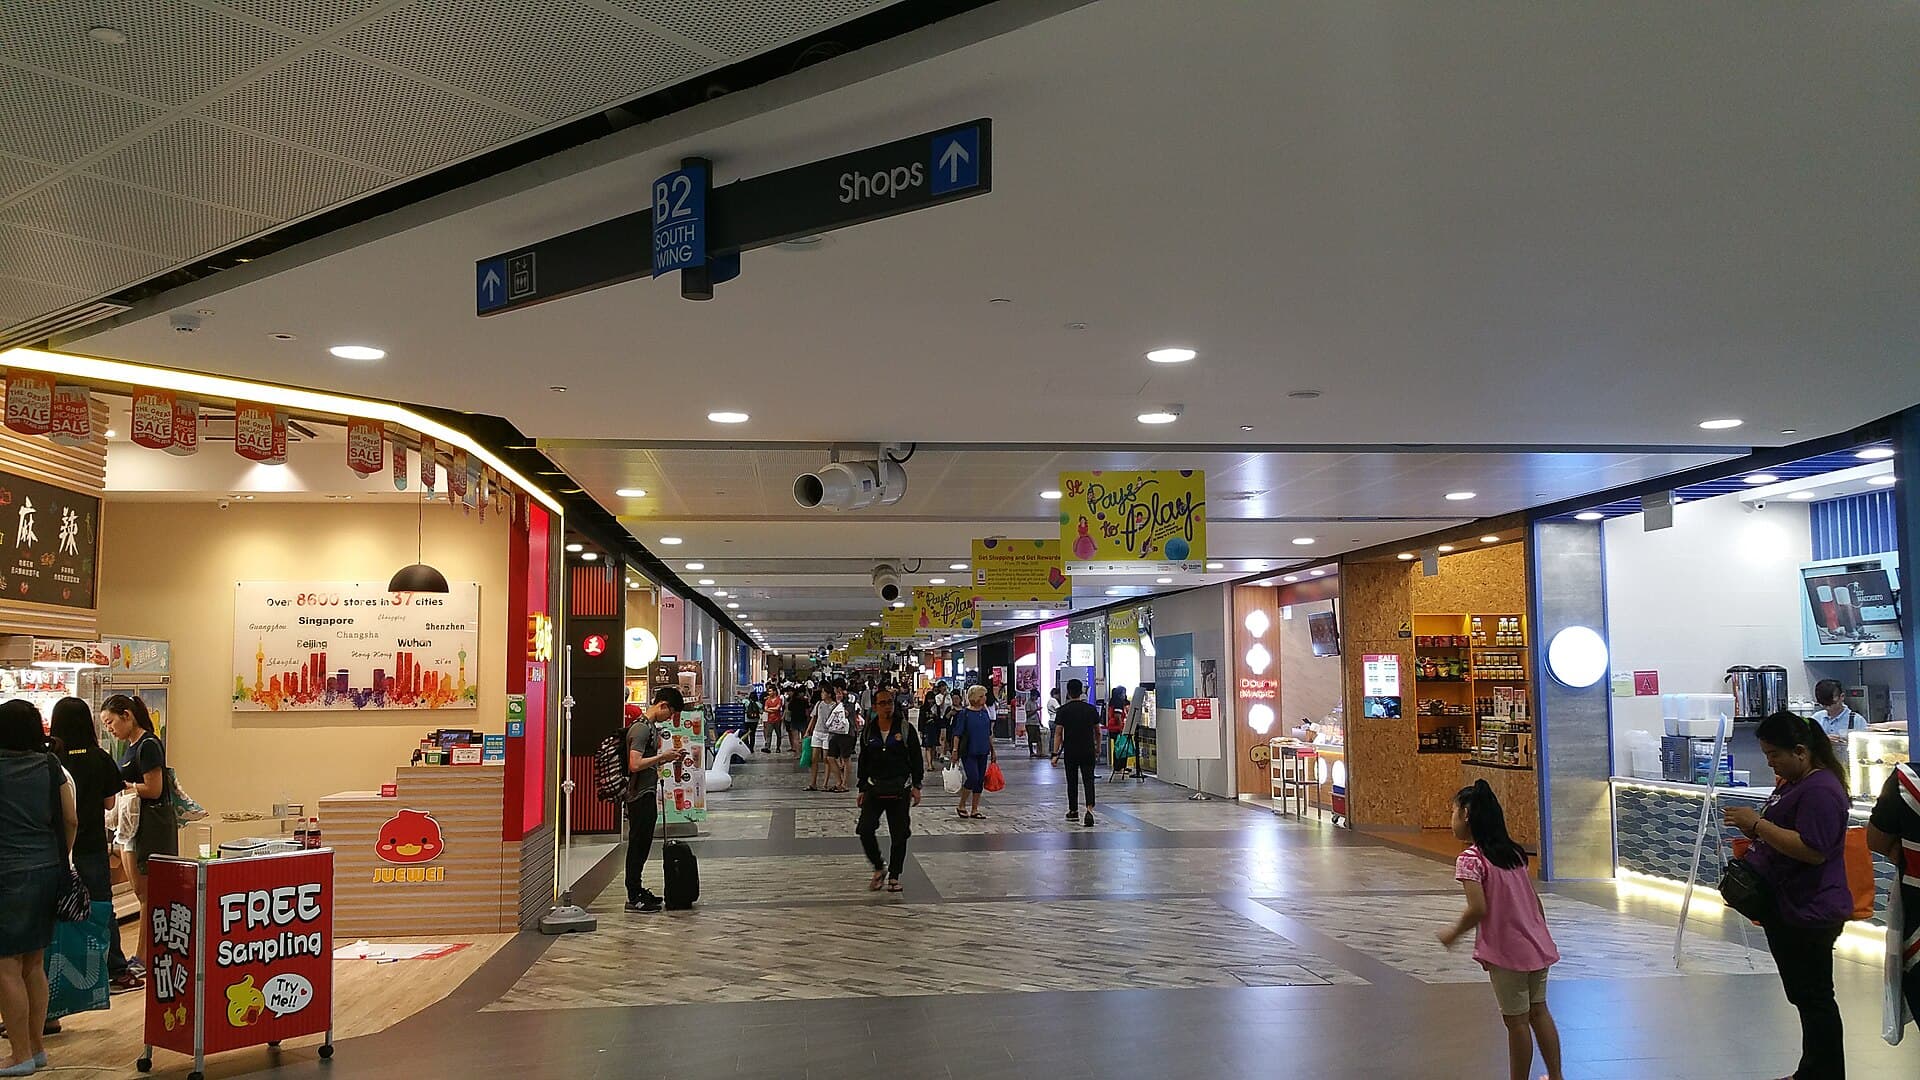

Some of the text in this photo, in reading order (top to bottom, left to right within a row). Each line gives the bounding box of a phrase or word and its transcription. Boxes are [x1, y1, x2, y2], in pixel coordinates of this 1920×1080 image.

[839, 160, 923, 204] Shops
[656, 175, 692, 226] B2
[655, 224, 696, 250] SOUTH
[656, 244, 692, 270] WING
[9, 404, 49, 421] SALE
[52, 419, 89, 432] SALE
[136, 420, 170, 436] SALE
[174, 430, 195, 444] ALE
[239, 433, 271, 448] SALE
[350, 447, 379, 462] SALE
[422, 463, 435, 473] SALE
[1066, 479, 1159, 515] It Pays
[16, 495, 39, 549] 麻
[1100, 520, 1120, 538] to
[1120, 491, 1205, 552] Play
[59, 506, 79, 556] 辣
[266, 591, 444, 607] Over 8600 stores in 37 cities
[926, 590, 960, 607] Pays
[932, 597, 976, 624] to Play
[248, 622, 288, 632] Guangzhou
[298, 616, 354, 627] Singapore
[425, 622, 465, 631] Shenzhen
[336, 631, 379, 640] Changsha
[397, 638, 432, 648] Wuhan
[296, 639, 328, 650] Beijing
[266, 656, 300, 667] Shanghai
[351, 650, 393, 660] Hong Kong
[1240, 679, 1278, 689] DOUGH
[1643, 676, 1653, 690] A
[1240, 689, 1276, 699] MAGIC
[372, 866, 445, 883] JUEWEI
[220, 883, 321, 933] FREE
[152, 902, 192, 956] 免费
[217, 931, 322, 966] Sampling
[154, 954, 189, 998] 试吃
[276, 977, 299, 993] Try
[270, 994, 297, 1008] Me!!
